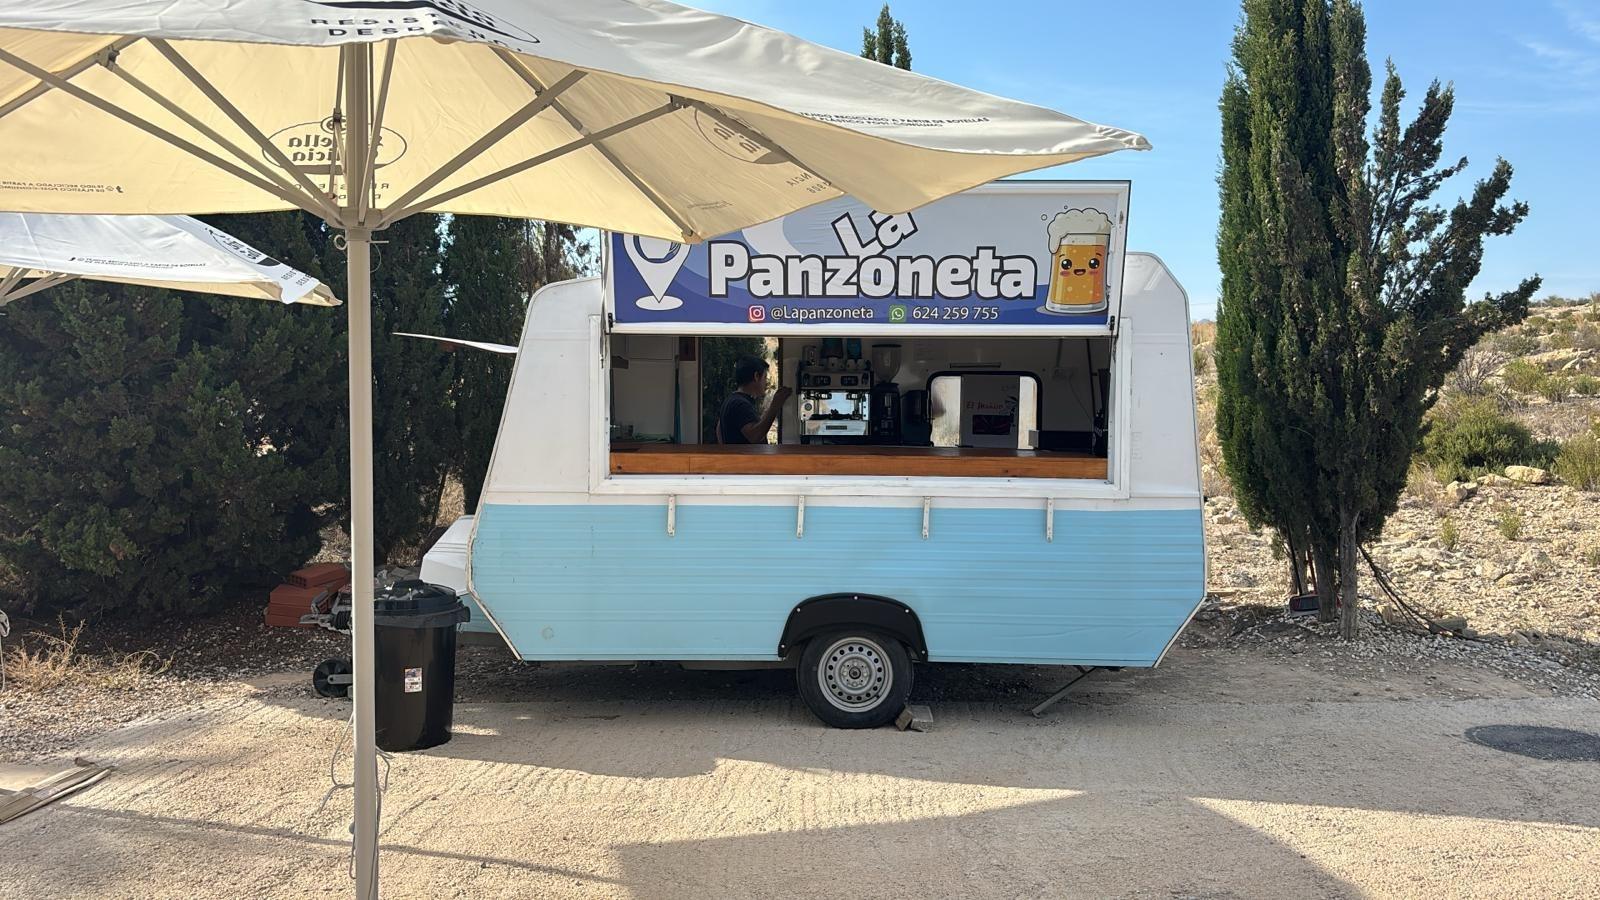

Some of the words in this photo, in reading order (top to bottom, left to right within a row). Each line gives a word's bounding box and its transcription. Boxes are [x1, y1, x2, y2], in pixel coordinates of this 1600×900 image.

[831, 210, 918, 256] La
[708, 240, 1038, 299] Panzoneta
[770, 305, 874, 322] @Lapanzoneta
[912, 306, 939, 320] 624
[942, 306, 969, 320] 259
[972, 307, 998, 320] 755
